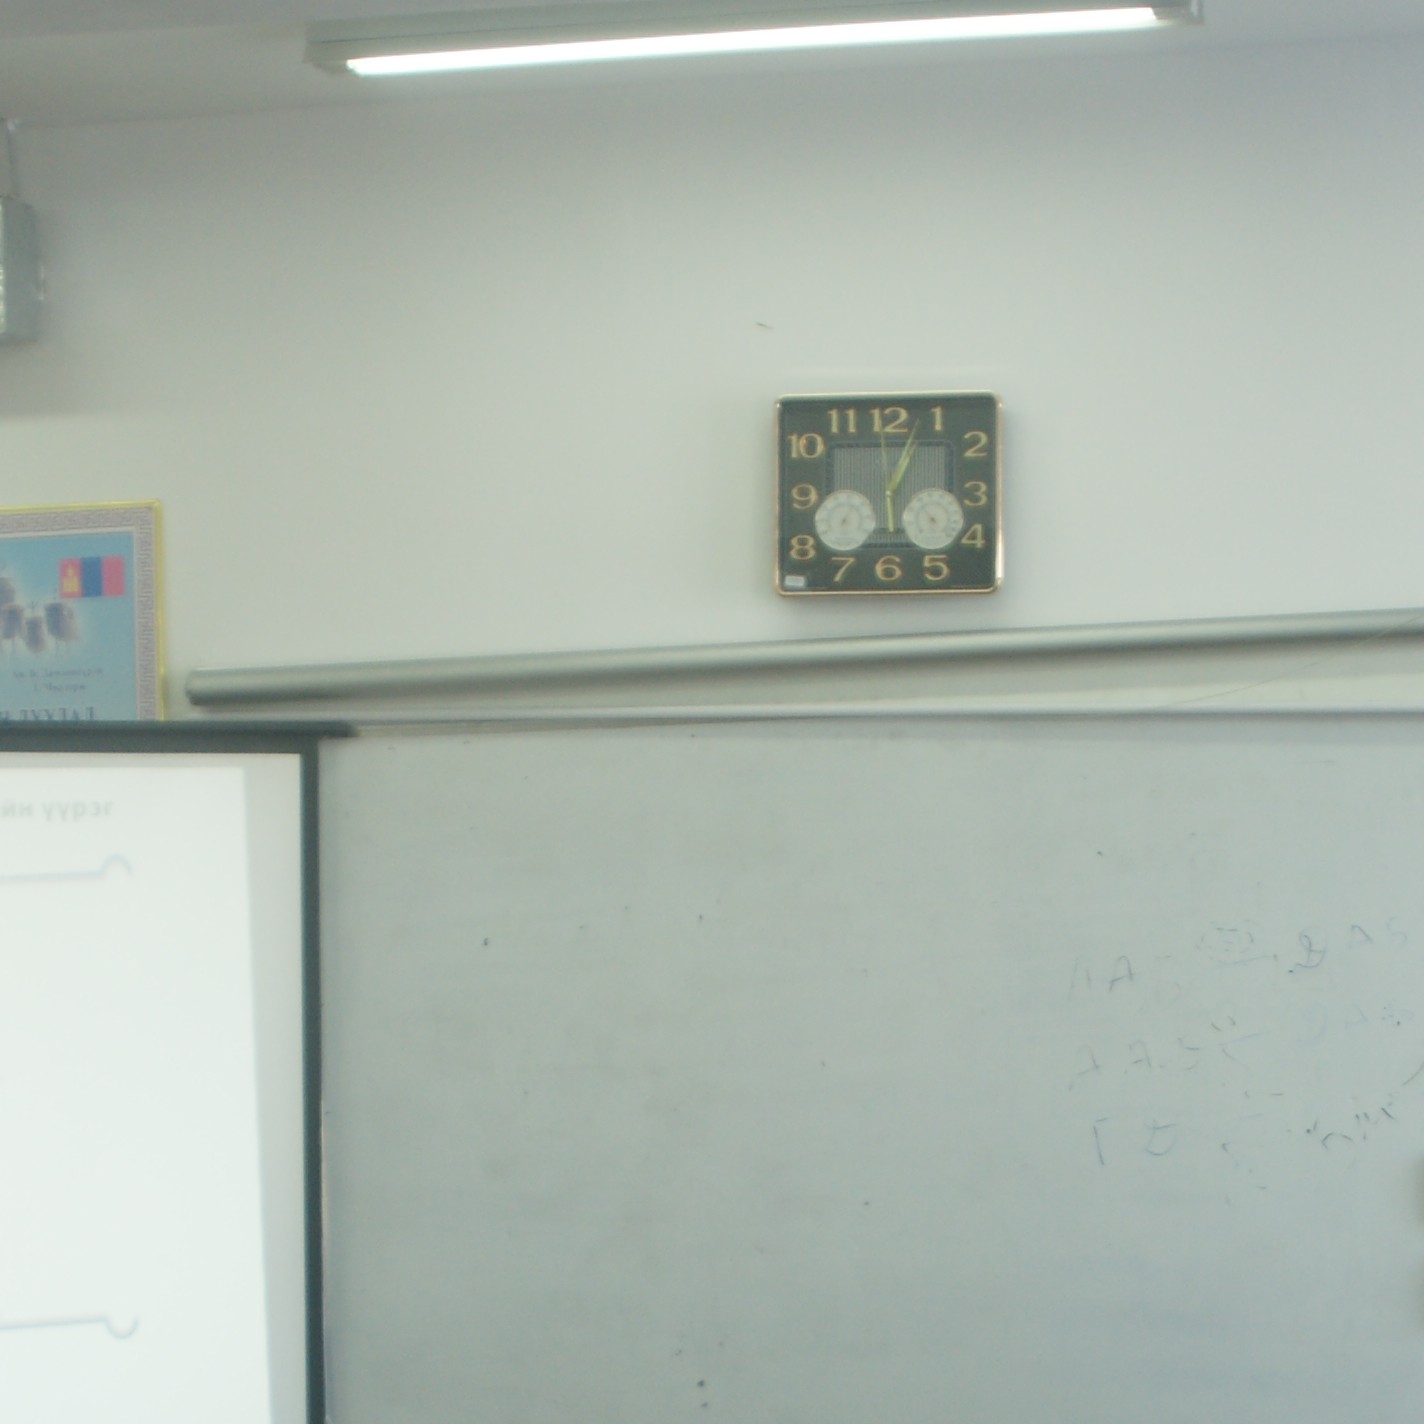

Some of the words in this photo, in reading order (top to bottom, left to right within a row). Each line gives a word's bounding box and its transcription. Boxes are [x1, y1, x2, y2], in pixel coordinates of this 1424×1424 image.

[828, 408, 856, 433] 11
[870, 407, 908, 432] 12
[931, 406, 942, 431] 1
[787, 433, 824, 458] 10
[964, 431, 988, 457] 2
[791, 484, 818, 509] 9
[964, 481, 987, 506] 3
[790, 535, 816, 560] 8
[961, 524, 985, 548] 4
[831, 557, 855, 582] 7
[876, 555, 902, 581] 6
[924, 555, 949, 581] 5
[44, 800, 115, 823] үүрэг
